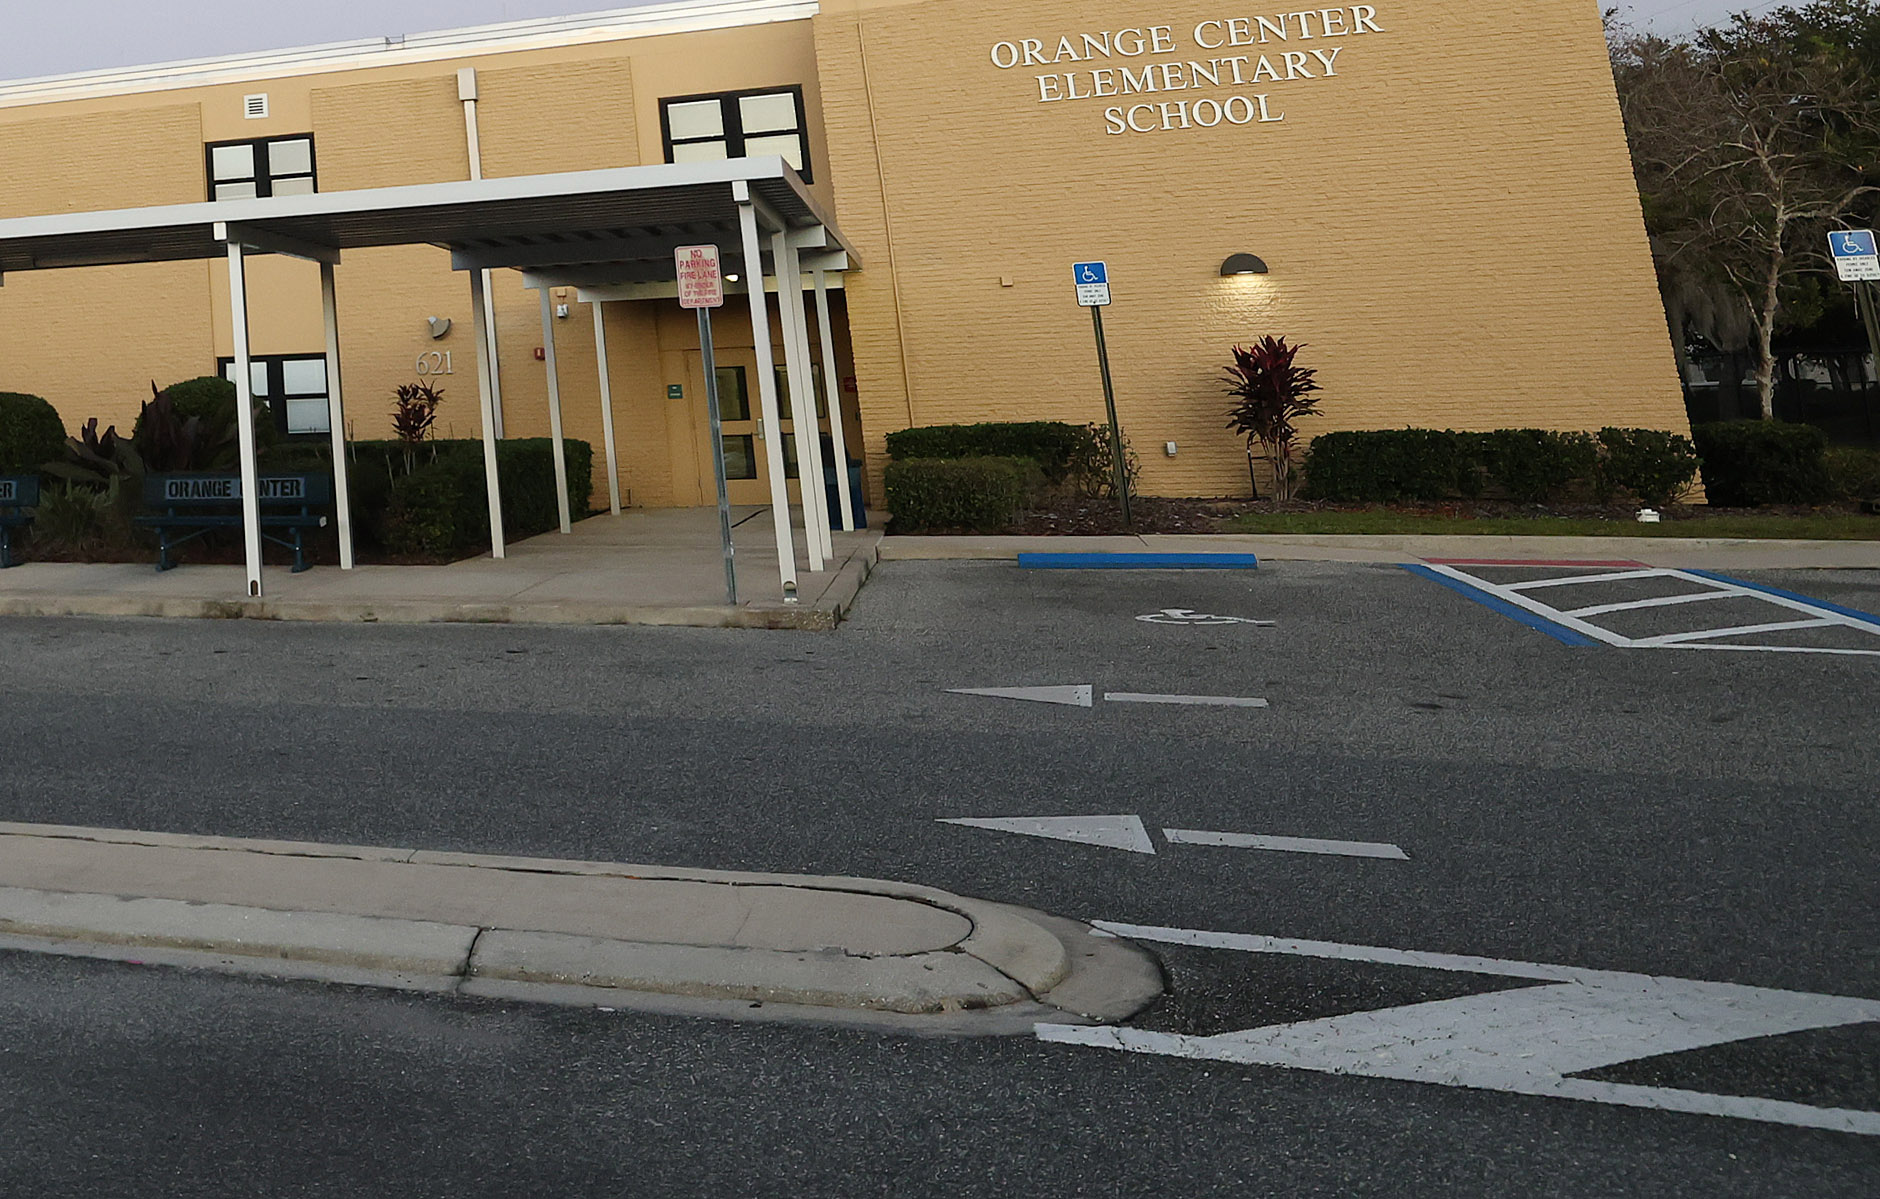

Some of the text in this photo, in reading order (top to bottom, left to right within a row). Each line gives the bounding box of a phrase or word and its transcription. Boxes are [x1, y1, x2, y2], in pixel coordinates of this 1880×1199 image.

[990, 4, 1385, 70] ORANGE CENTER
[1035, 47, 1343, 103] ELEMENTARY
[1105, 94, 1285, 135] SCHOOL
[680, 258, 716, 269] PARKING
[690, 249, 703, 258] NO
[680, 270, 718, 280] FIRE LANE
[416, 350, 455, 375] 621
[168, 480, 300, 498] ORANGE NTER
